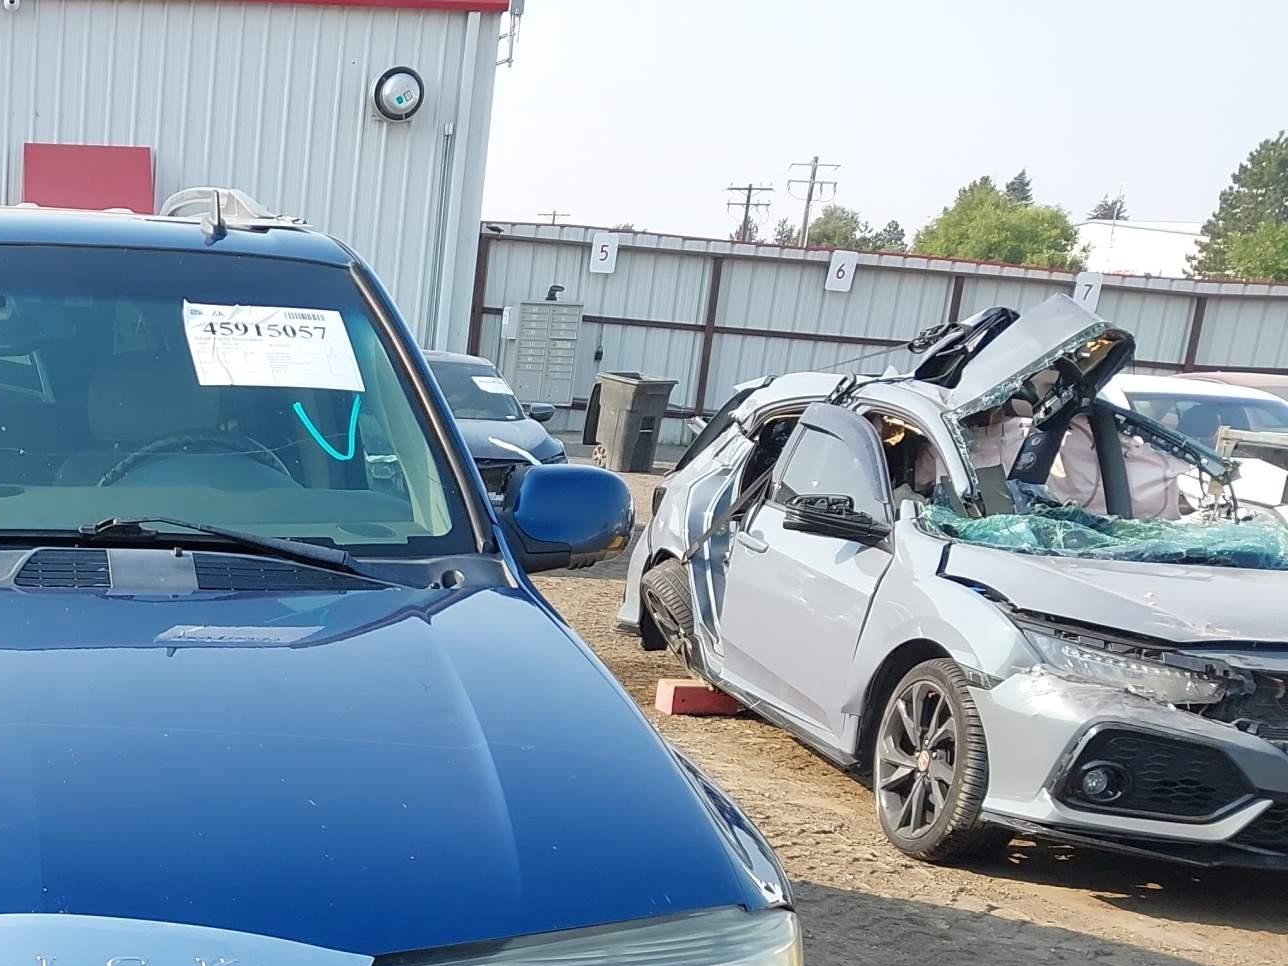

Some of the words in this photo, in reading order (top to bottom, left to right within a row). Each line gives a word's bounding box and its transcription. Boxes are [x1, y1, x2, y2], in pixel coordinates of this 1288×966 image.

[599, 244, 609, 262] 5
[835, 263, 846, 280] 6
[1082, 283, 1094, 301] 7
[203, 321, 327, 340] 45915057
